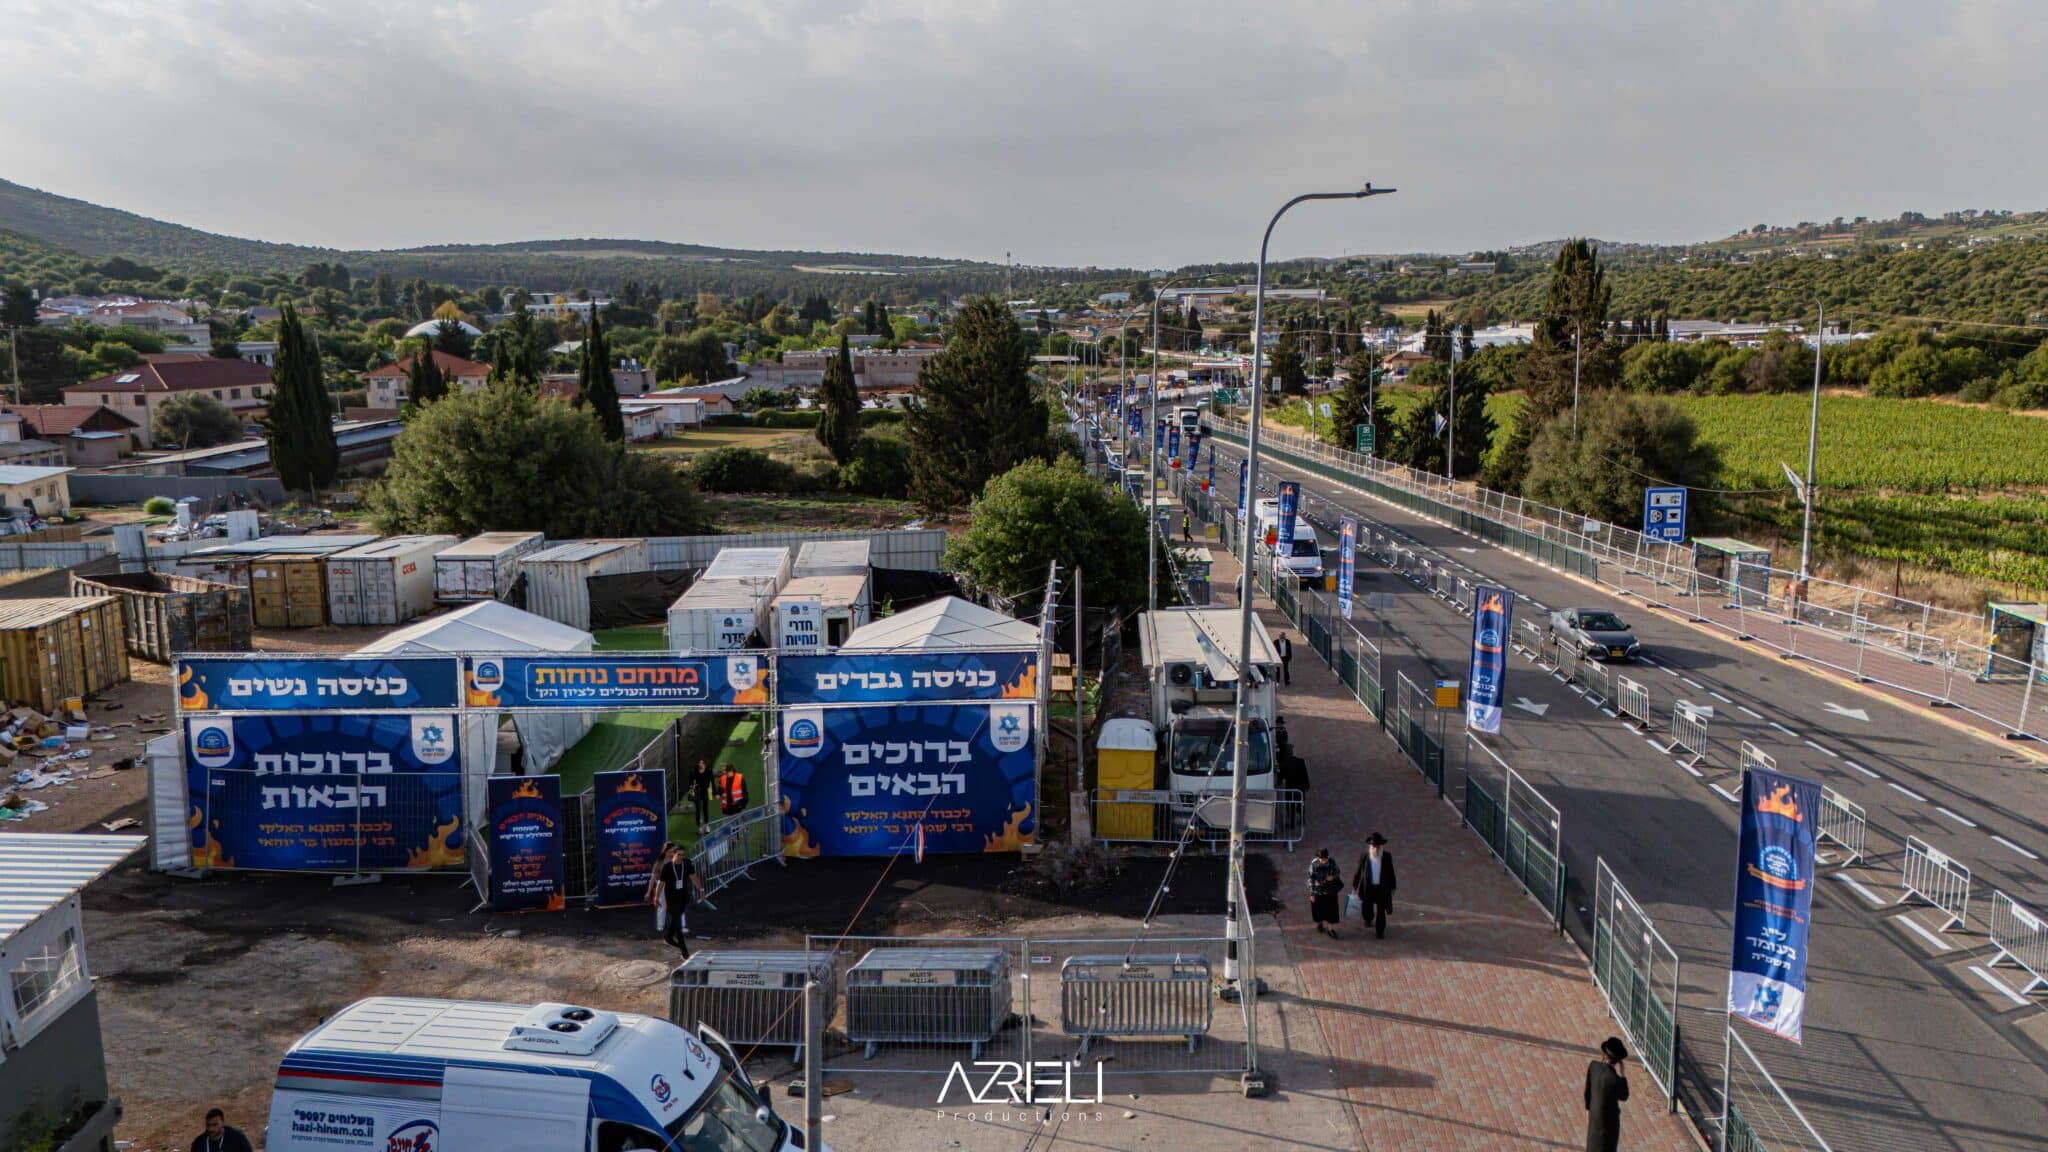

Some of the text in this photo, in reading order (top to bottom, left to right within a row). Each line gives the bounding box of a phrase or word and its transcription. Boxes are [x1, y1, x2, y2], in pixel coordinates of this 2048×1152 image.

[789, 620, 813, 632] חדרי
[535, 668, 699, 685] מתחם נוחות
[816, 670, 997, 690] כניסה גברים
[228, 677, 408, 696] כניסה נשים
[563, 687, 596, 698] לציון
[600, 687, 648, 696] העולים
[652, 686, 700, 696] לרווחת
[842, 740, 972, 765] ברוכים
[253, 751, 393, 776] ברוכות
[848, 772, 966, 797] הבאים
[262, 784, 387, 809] הבאות
[883, 825, 900, 833] בר
[904, 824, 947, 834] שמון
[951, 824, 973, 832] רבי
[1745, 936, 1797, 960] בעומר
[328, 1112, 375, 1126] משלוחים
[292, 1120, 374, 1138] hazi-hinam.co.il
